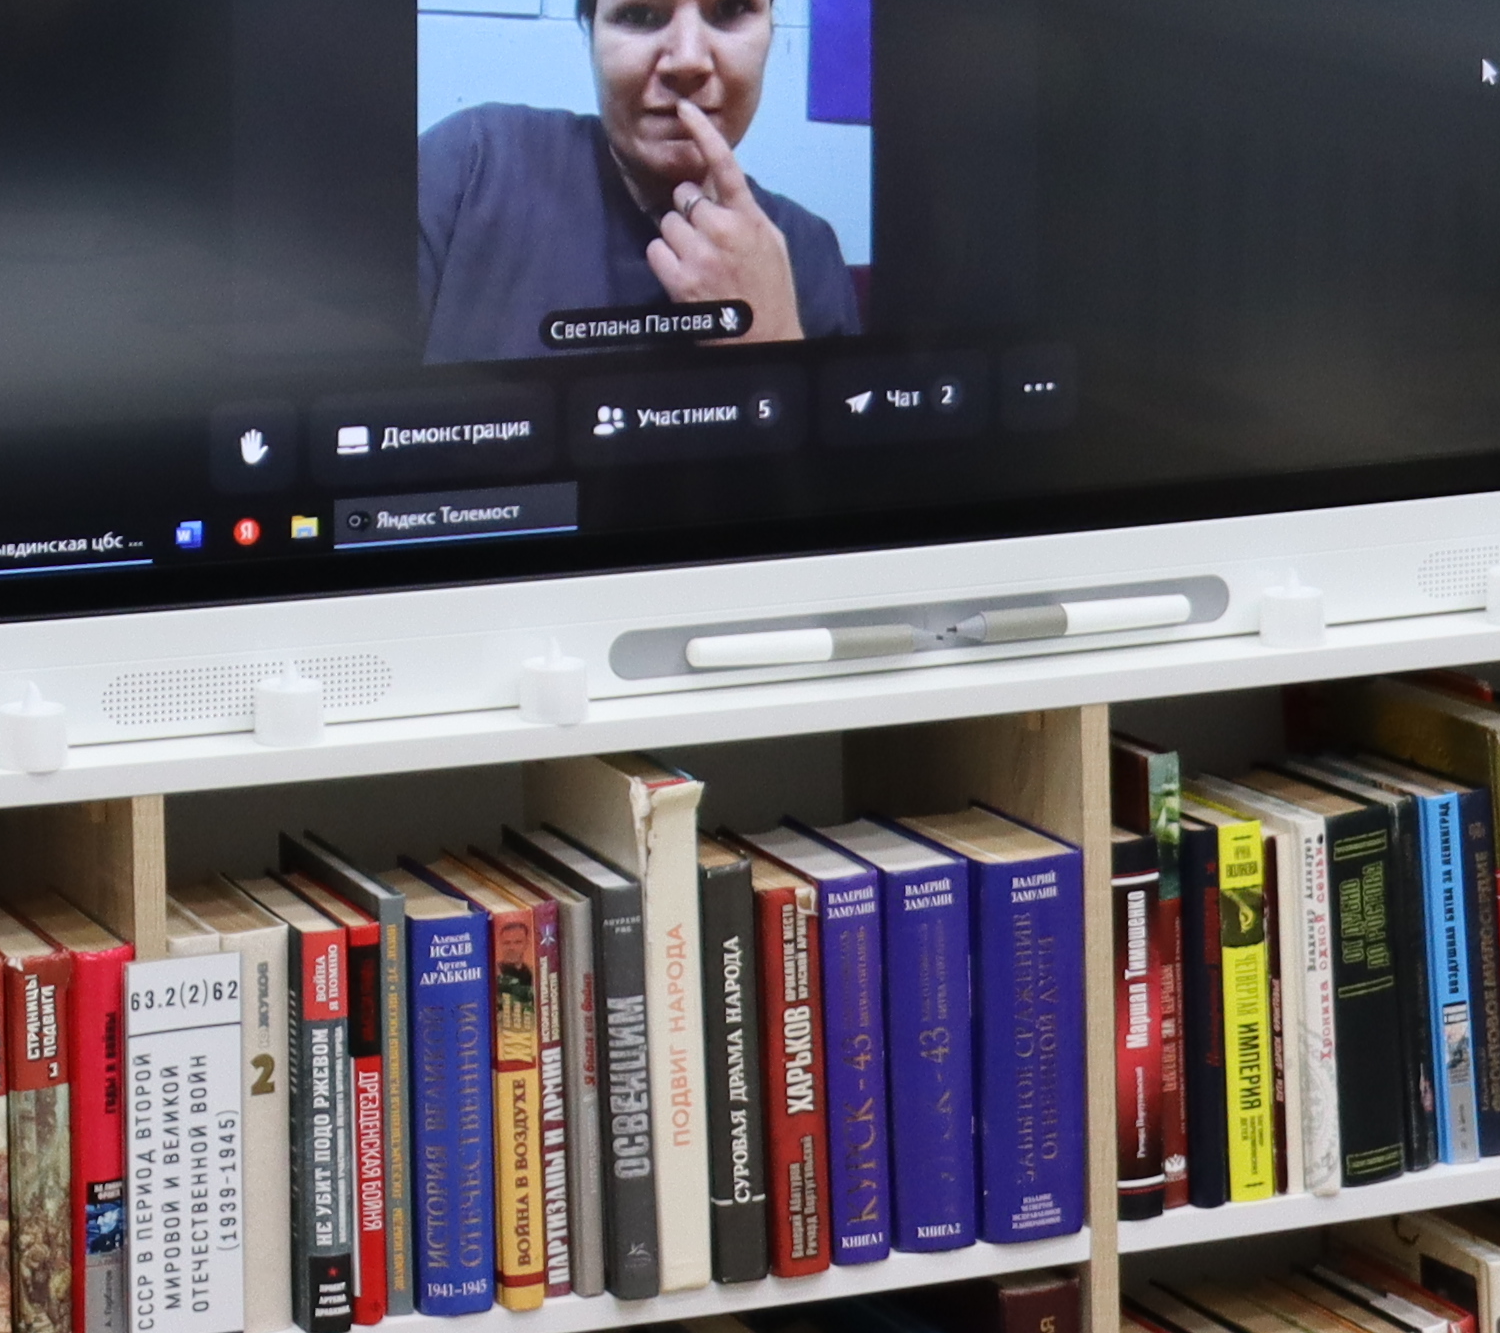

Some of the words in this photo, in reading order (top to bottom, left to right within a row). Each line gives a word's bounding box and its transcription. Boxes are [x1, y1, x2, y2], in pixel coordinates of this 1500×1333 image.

[550, 320, 640, 340] Светлана
[645, 313, 713, 333] Патова
[636, 403, 738, 429] Участники
[758, 400, 772, 419] 5
[886, 388, 921, 409] Чат
[940, 385, 954, 405] 2
[381, 417, 531, 451] Демонстрация
[90, 532, 124, 554] цбс
[376, 507, 435, 530] Яндекс
[438, 501, 520, 524] Телемост
[131, 980, 239, 1012] 63.2(2)62
[665, 923, 689, 1032] НАРОДА
[722, 936, 744, 1023] НАРОДА
[186, 1053, 207, 1114] ВОЙН
[312, 1028, 329, 1109] РЖЕВОМ
[607, 994, 651, 1179] ОСВЕНЦИМ
[726, 1030, 749, 1101] ДРАМА
[784, 1005, 815, 1113] ХАРЬКОВ
[132, 1053, 151, 1140] ВТОРОЙ
[159, 1065, 181, 1166] ВЕЛИКОЙ
[669, 1045, 692, 1147] ПОДВИГ
[313, 1114, 334, 1161] ПОДО
[728, 1110, 752, 1203] СУРОВАЯ
[136, 1148, 156, 1242] ПЕРИОД
[164, 1175, 180, 1189] И
[215, 1109, 240, 1252] (1939-1945)
[315, 1168, 333, 1215] УБИТ
[188, 1124, 210, 1313] ОТЕЧЕСТВЕННОЙ
[316, 1220, 333, 1246] НЕ
[138, 1249, 153, 1269] В
[163, 1199, 182, 1309] МИРОВОЙ
[138, 1271, 154, 1331] СССР
